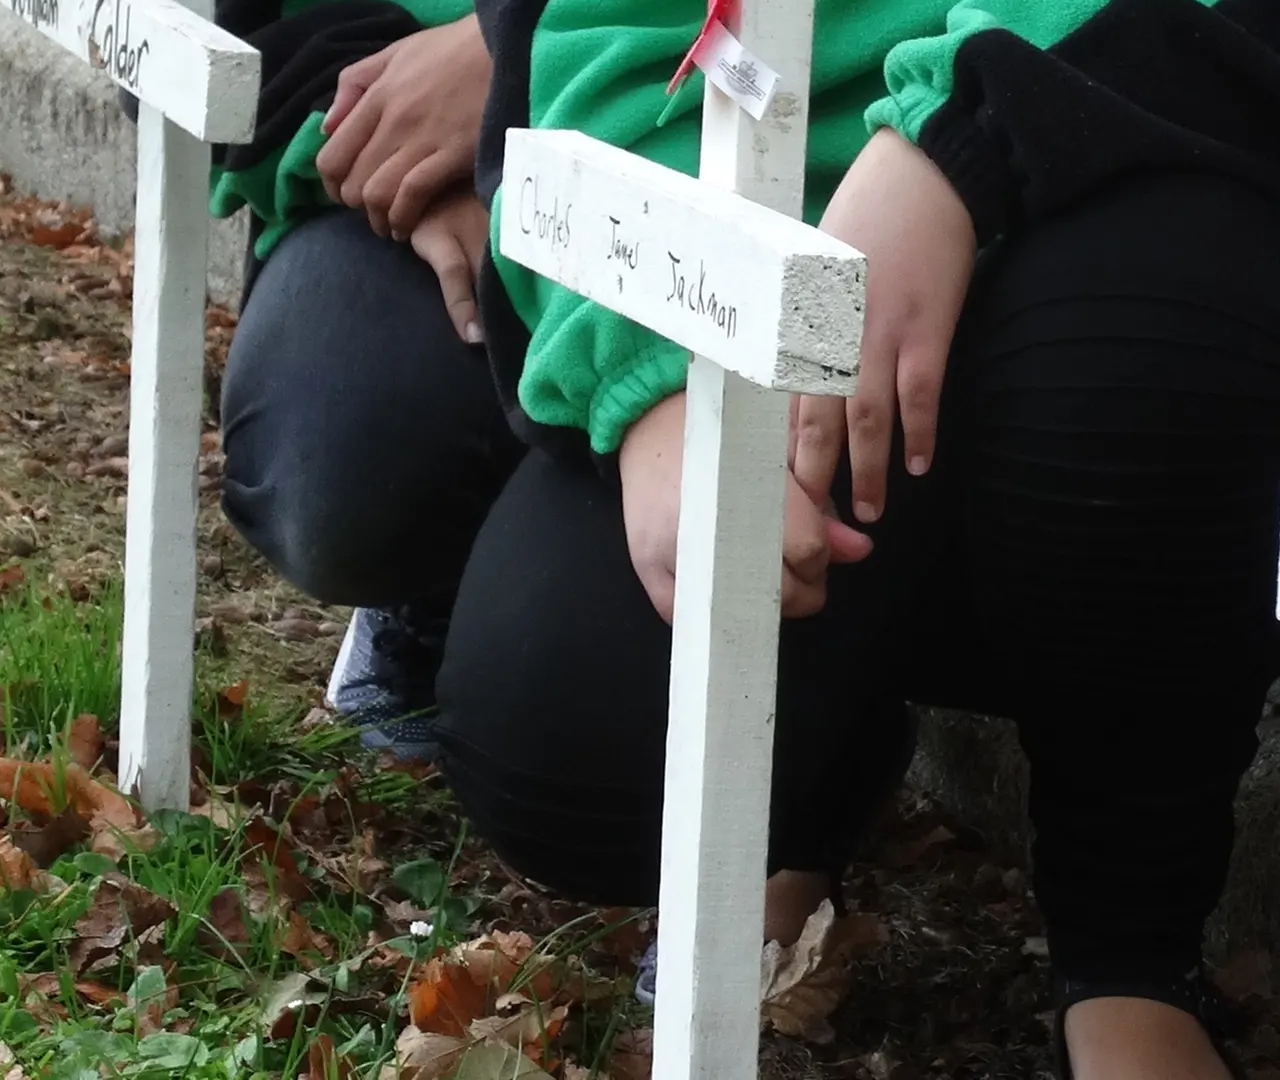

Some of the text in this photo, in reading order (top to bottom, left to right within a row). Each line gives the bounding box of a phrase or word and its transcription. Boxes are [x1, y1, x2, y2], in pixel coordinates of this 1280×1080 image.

[519, 177, 738, 339] Charles James Jackman
